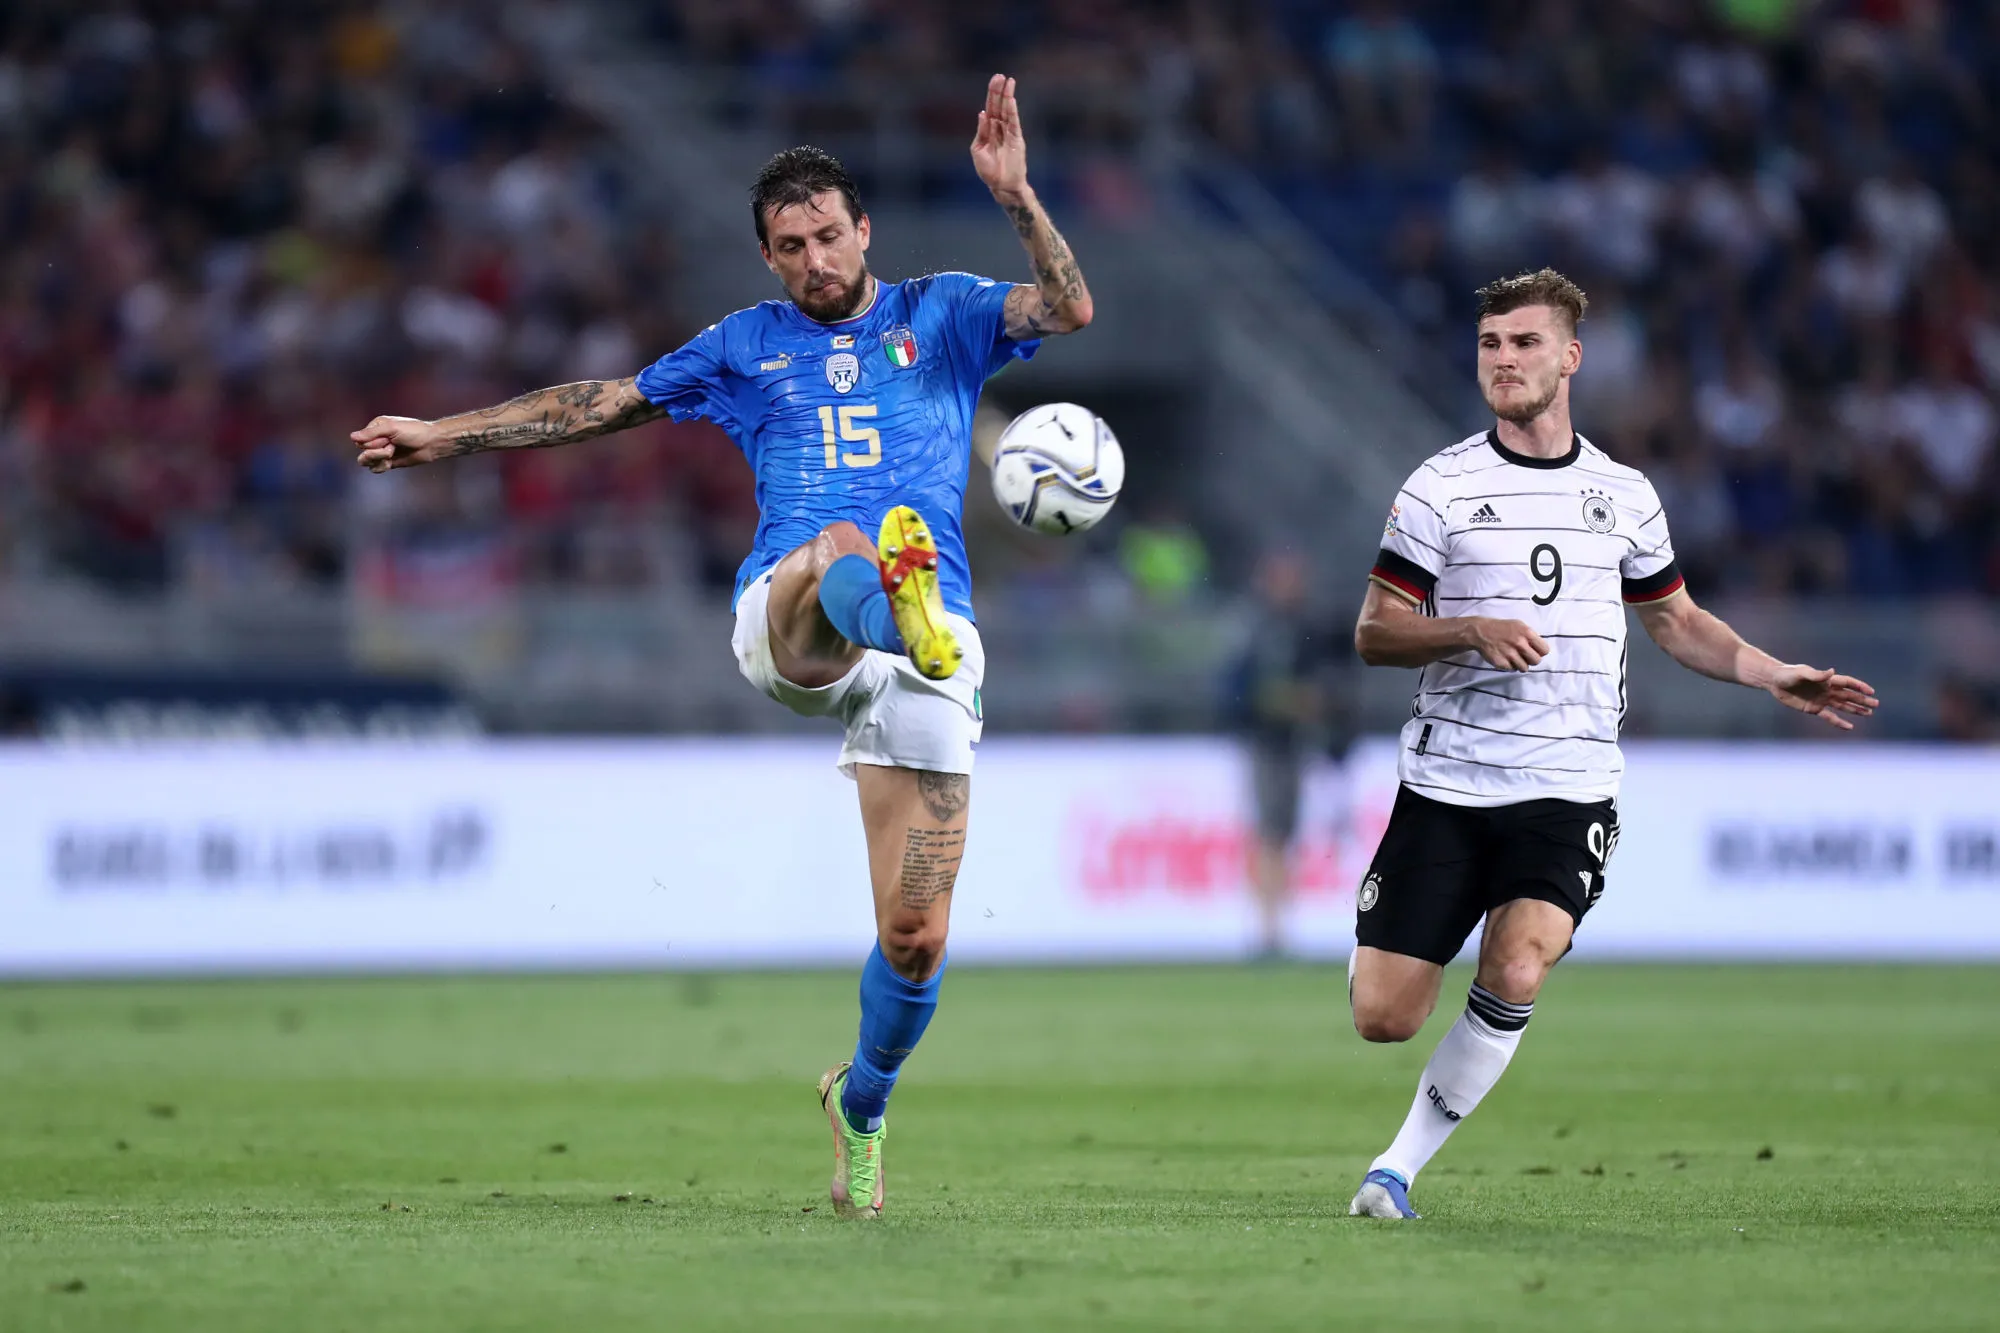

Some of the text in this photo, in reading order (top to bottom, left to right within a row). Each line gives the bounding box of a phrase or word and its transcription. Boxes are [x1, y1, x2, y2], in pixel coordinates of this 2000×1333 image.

[818, 404, 882, 469] 15
[1469, 515, 1501, 523] adidas
[1530, 543, 1563, 606] 9
